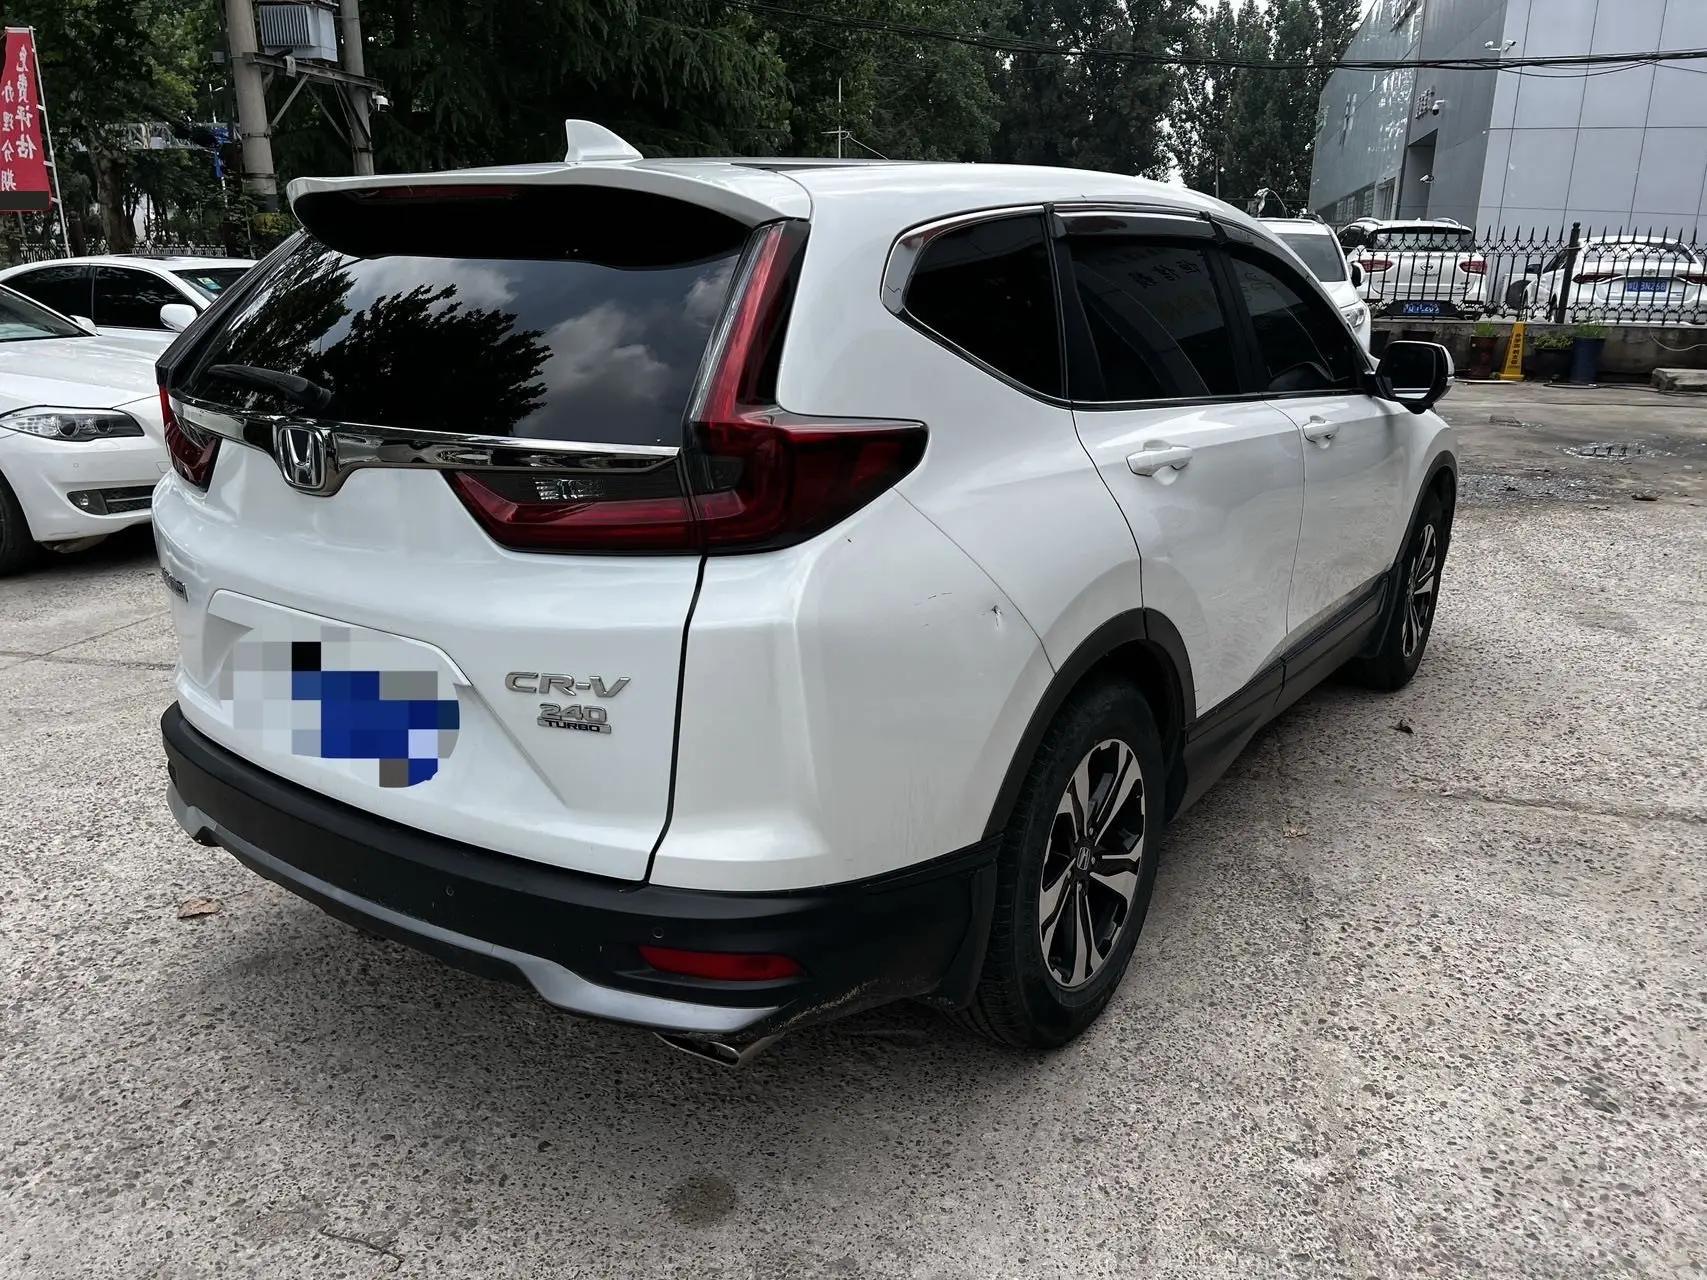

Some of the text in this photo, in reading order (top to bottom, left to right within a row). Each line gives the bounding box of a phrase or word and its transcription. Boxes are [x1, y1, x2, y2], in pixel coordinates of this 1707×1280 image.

[504, 671, 631, 698] CR-V
[540, 702, 606, 722] 240
[547, 720, 600, 733] TURBO
